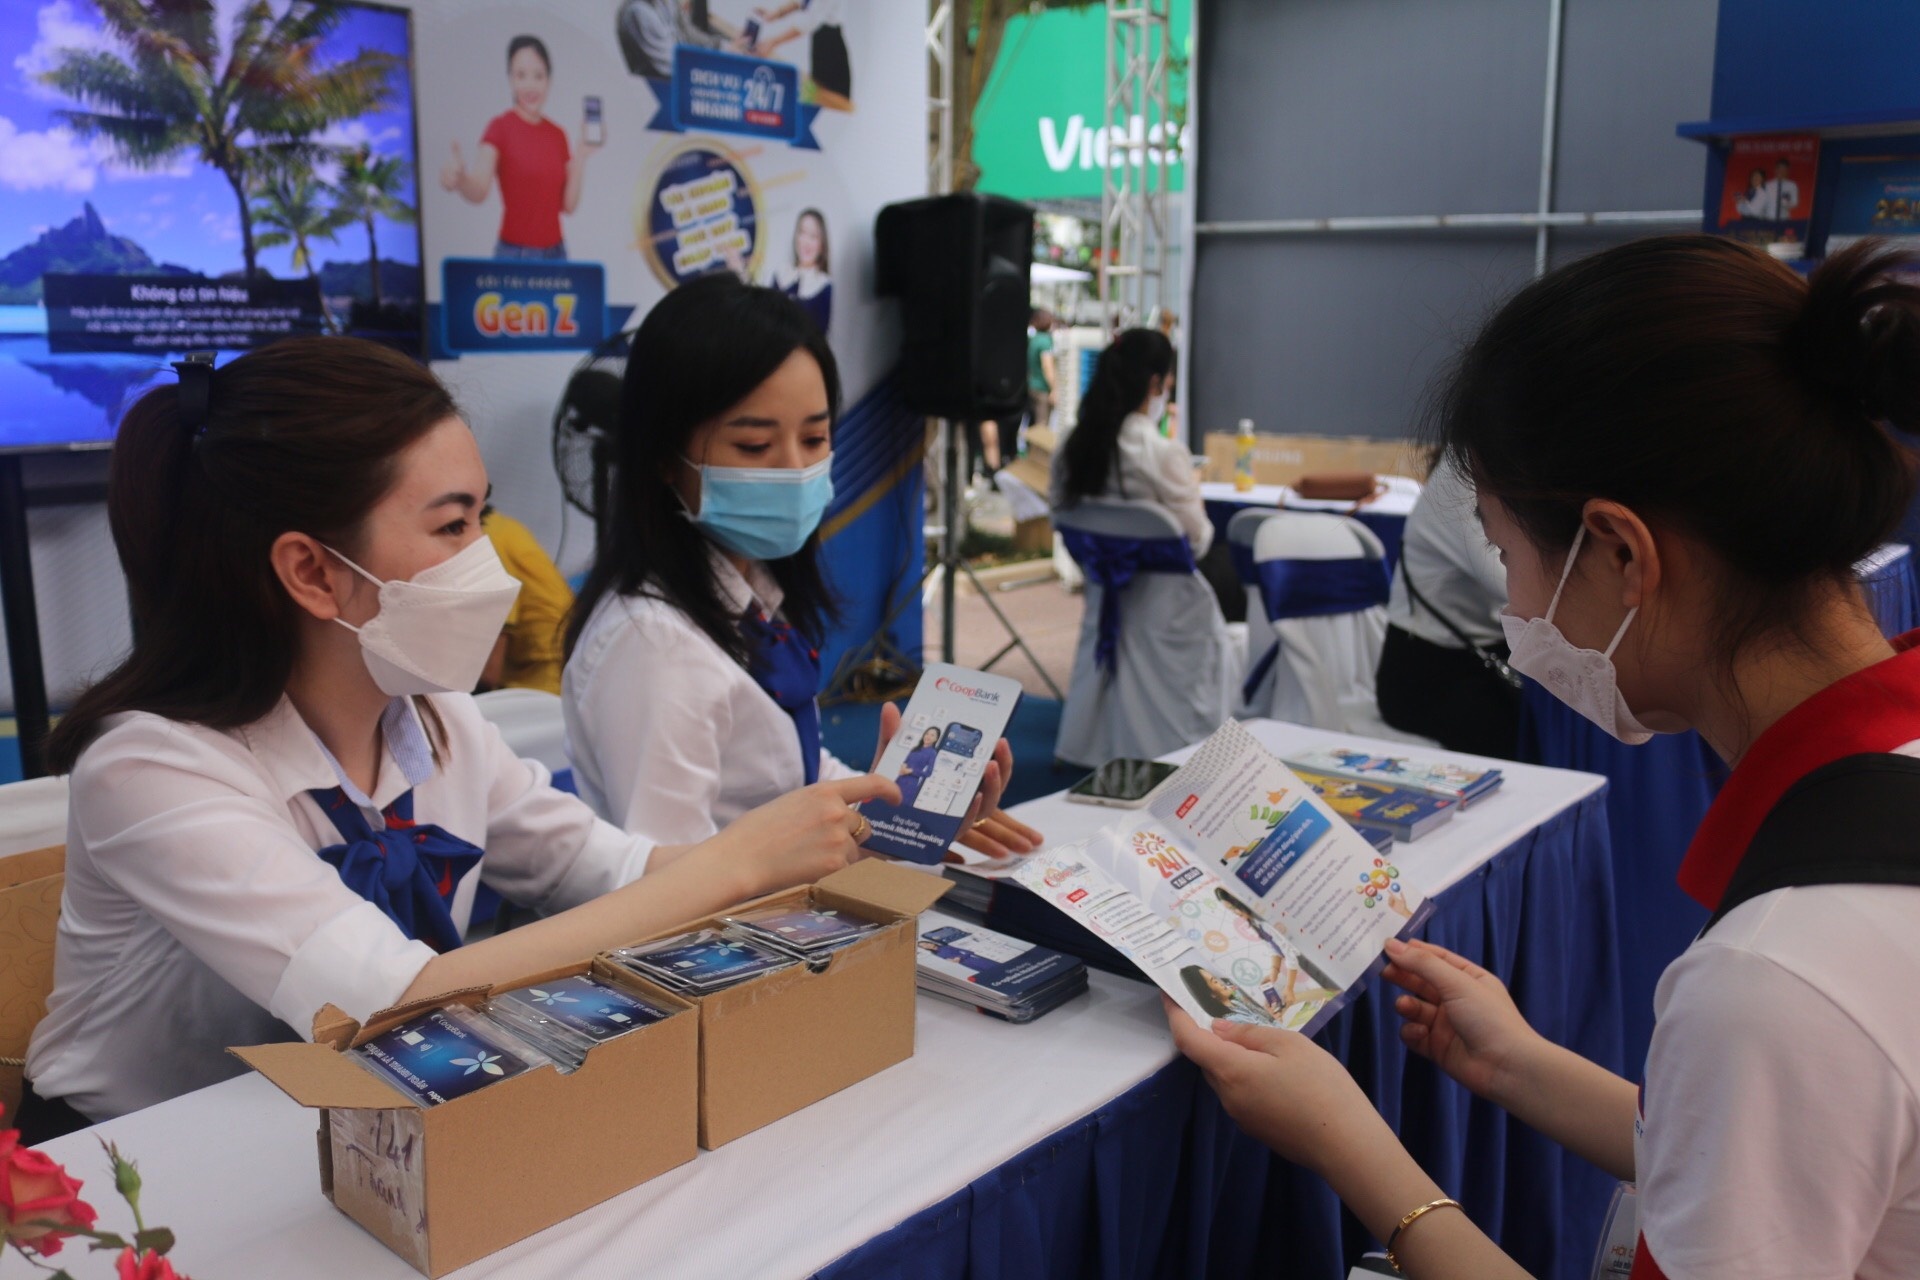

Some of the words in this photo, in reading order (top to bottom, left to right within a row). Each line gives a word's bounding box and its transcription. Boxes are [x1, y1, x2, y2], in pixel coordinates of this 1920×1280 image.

[474, 291, 549, 338] Gen
[552, 293, 580, 338] Z
[917, 832, 945, 847] Banking
